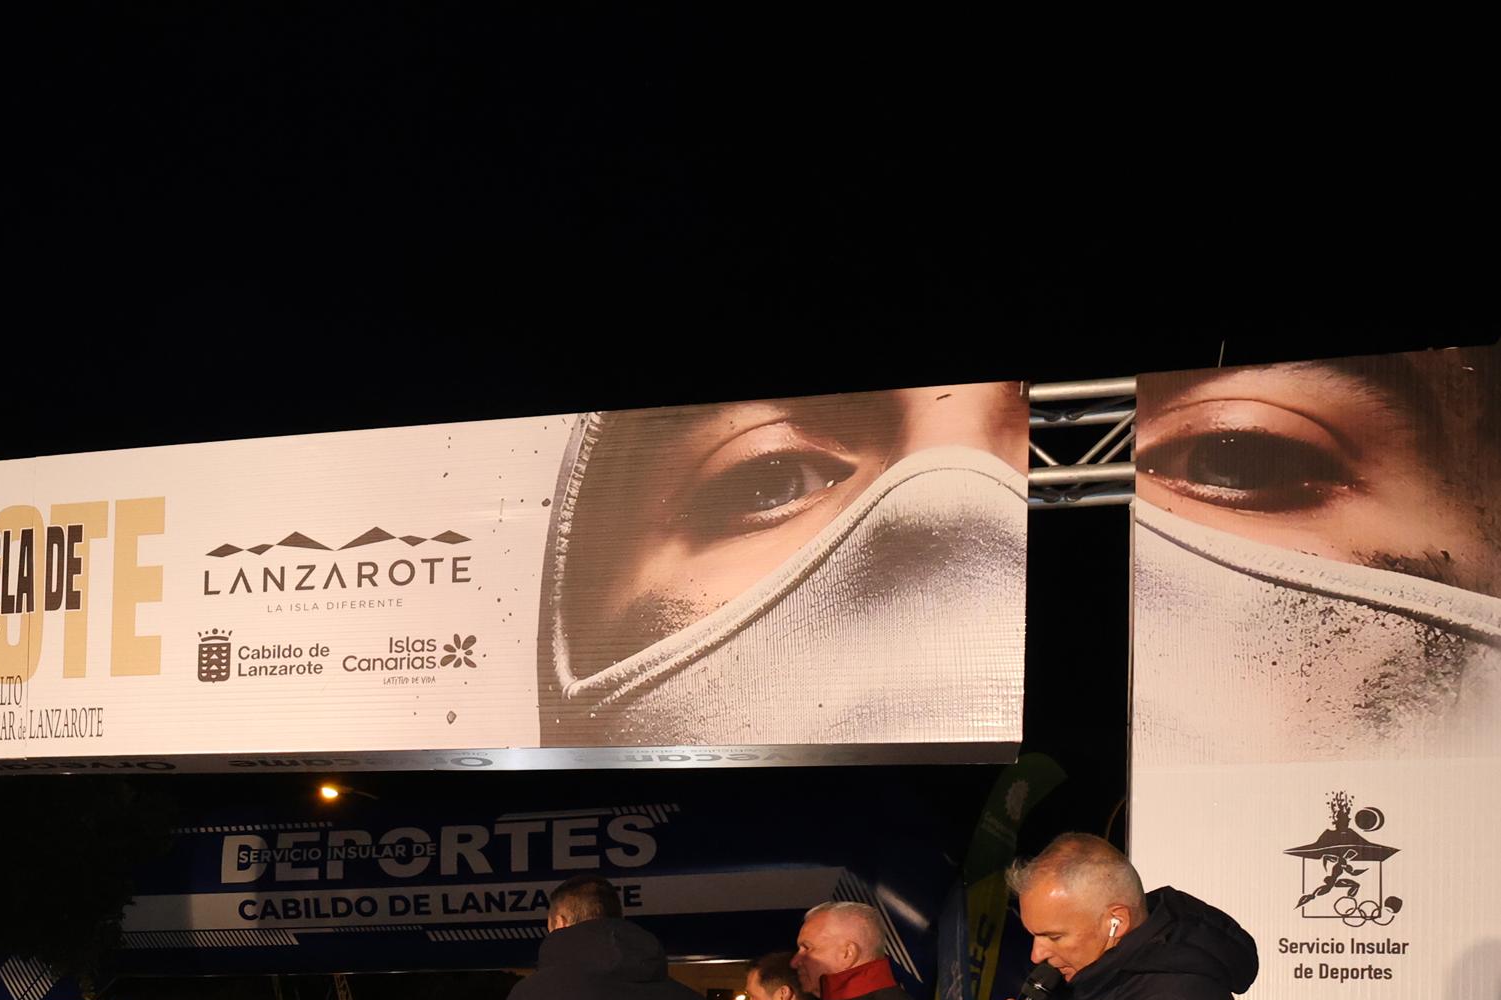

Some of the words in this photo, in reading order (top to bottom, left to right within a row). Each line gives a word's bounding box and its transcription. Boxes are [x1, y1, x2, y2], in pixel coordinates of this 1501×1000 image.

[44, 525, 83, 612] DE
[204, 556, 472, 595] LANZAROTE
[267, 603, 282, 613] LA
[290, 602, 320, 612] ISLA
[327, 598, 403, 610] DIFERENTE
[238, 644, 304, 660] Cabildo
[309, 643, 330, 658] de
[389, 636, 437, 654] Islas
[238, 661, 324, 677] Lanzarote
[342, 654, 437, 672] Canarias
[18, 718, 26, 740] de
[28, 707, 104, 739] LANZAROTE
[221, 814, 658, 884] DEPORTES
[239, 848, 322, 865] SERVICIO
[327, 843, 406, 859] INSULAR
[413, 842, 437, 857] DE
[238, 895, 378, 921] CABILDO
[389, 893, 431, 917] DE
[441, 884, 642, 915] LANZAE
[1278, 938, 1345, 954] Servicio
[1351, 938, 1409, 954] Insular
[1294, 963, 1313, 979] de
[1319, 963, 1393, 983] Deportes
